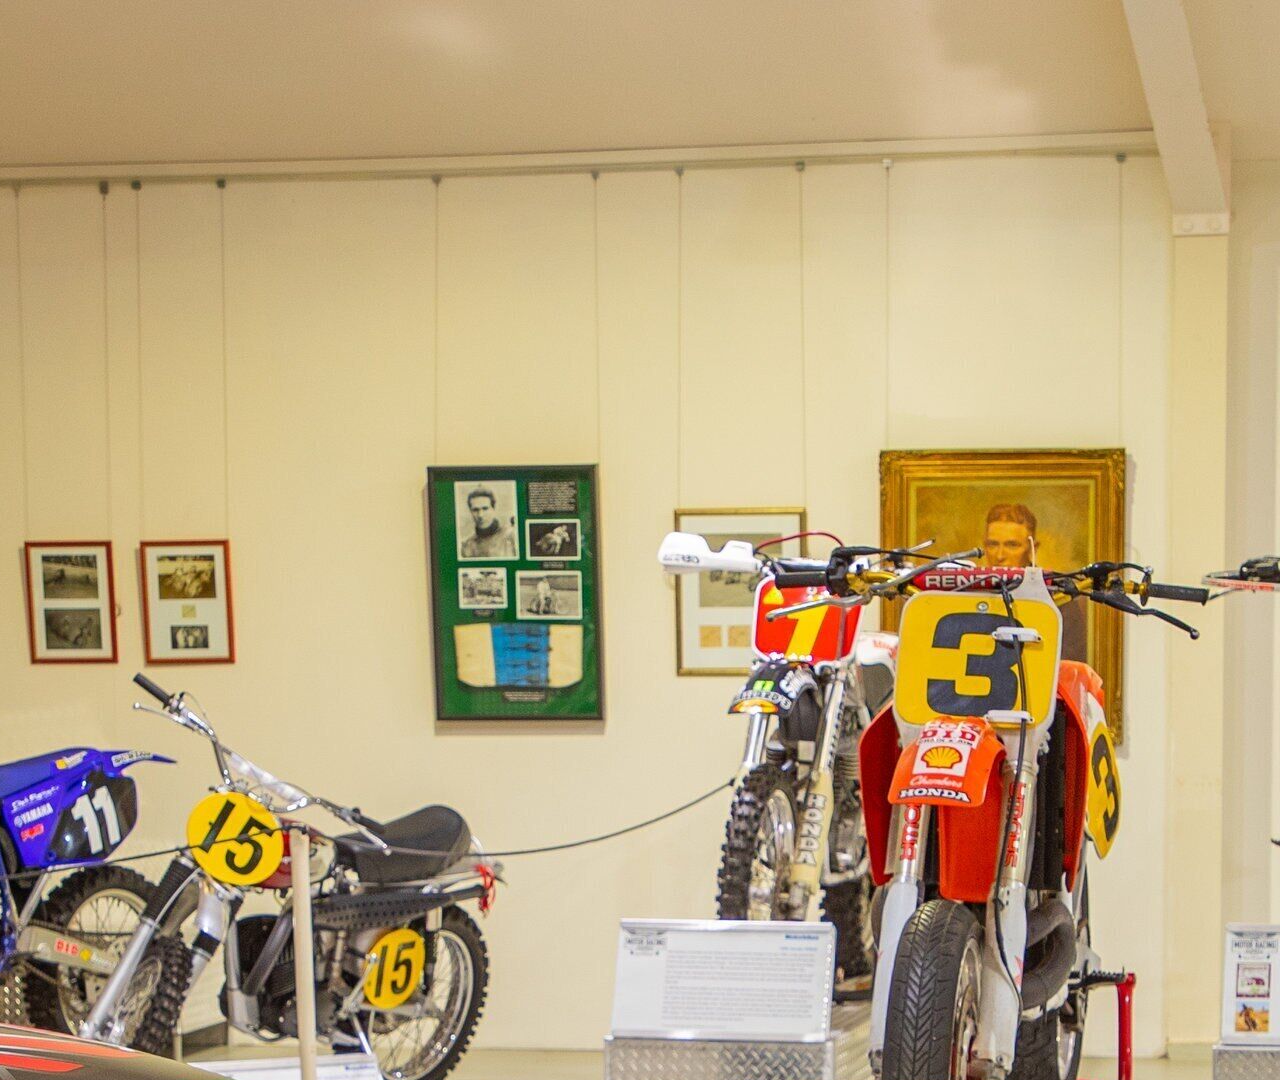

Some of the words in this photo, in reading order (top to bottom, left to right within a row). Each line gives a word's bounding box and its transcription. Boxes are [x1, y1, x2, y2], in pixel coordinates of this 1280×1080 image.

[925, 574, 1024, 589] RENTHA
[786, 596, 830, 660] 1
[927, 612, 1025, 717] 3
[70, 785, 121, 855] 11
[900, 788, 971, 803] HONDA
[1092, 734, 1119, 841] 3
[200, 799, 278, 876] 15
[796, 793, 827, 866] HONDA
[374, 941, 416, 998] 15
